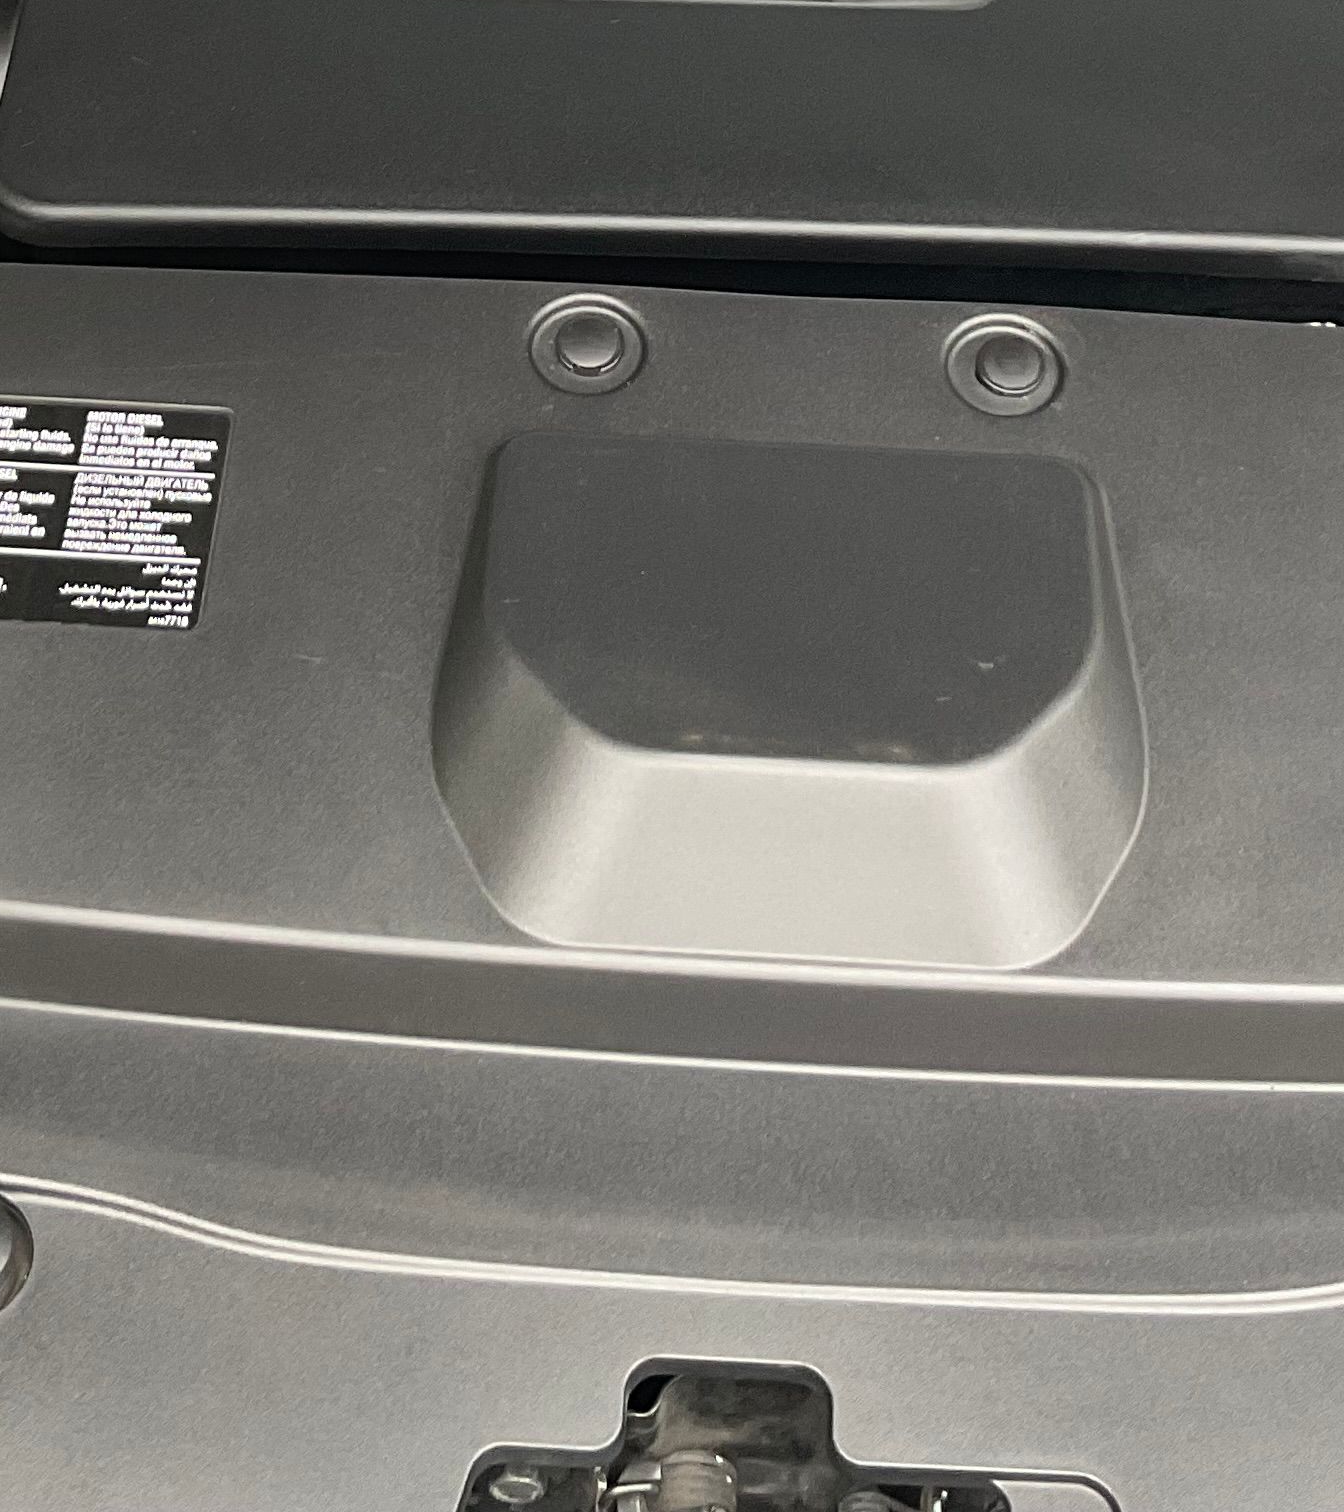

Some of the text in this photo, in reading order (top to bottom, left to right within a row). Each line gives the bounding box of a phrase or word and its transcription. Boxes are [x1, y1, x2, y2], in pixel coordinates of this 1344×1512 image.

[87, 410, 164, 427] MOTOR DIESEL
[32, 440, 75, 455] damage
[83, 433, 99, 444] No
[155, 437, 170, 448] de
[81, 443, 96, 454] Se
[136, 457, 151, 468] en
[151, 457, 162, 469] el
[73, 472, 210, 492] ДИЗЕЛЬНЫЙ ДВИГАТЕЛЬ
[3, 490, 19, 502] de
